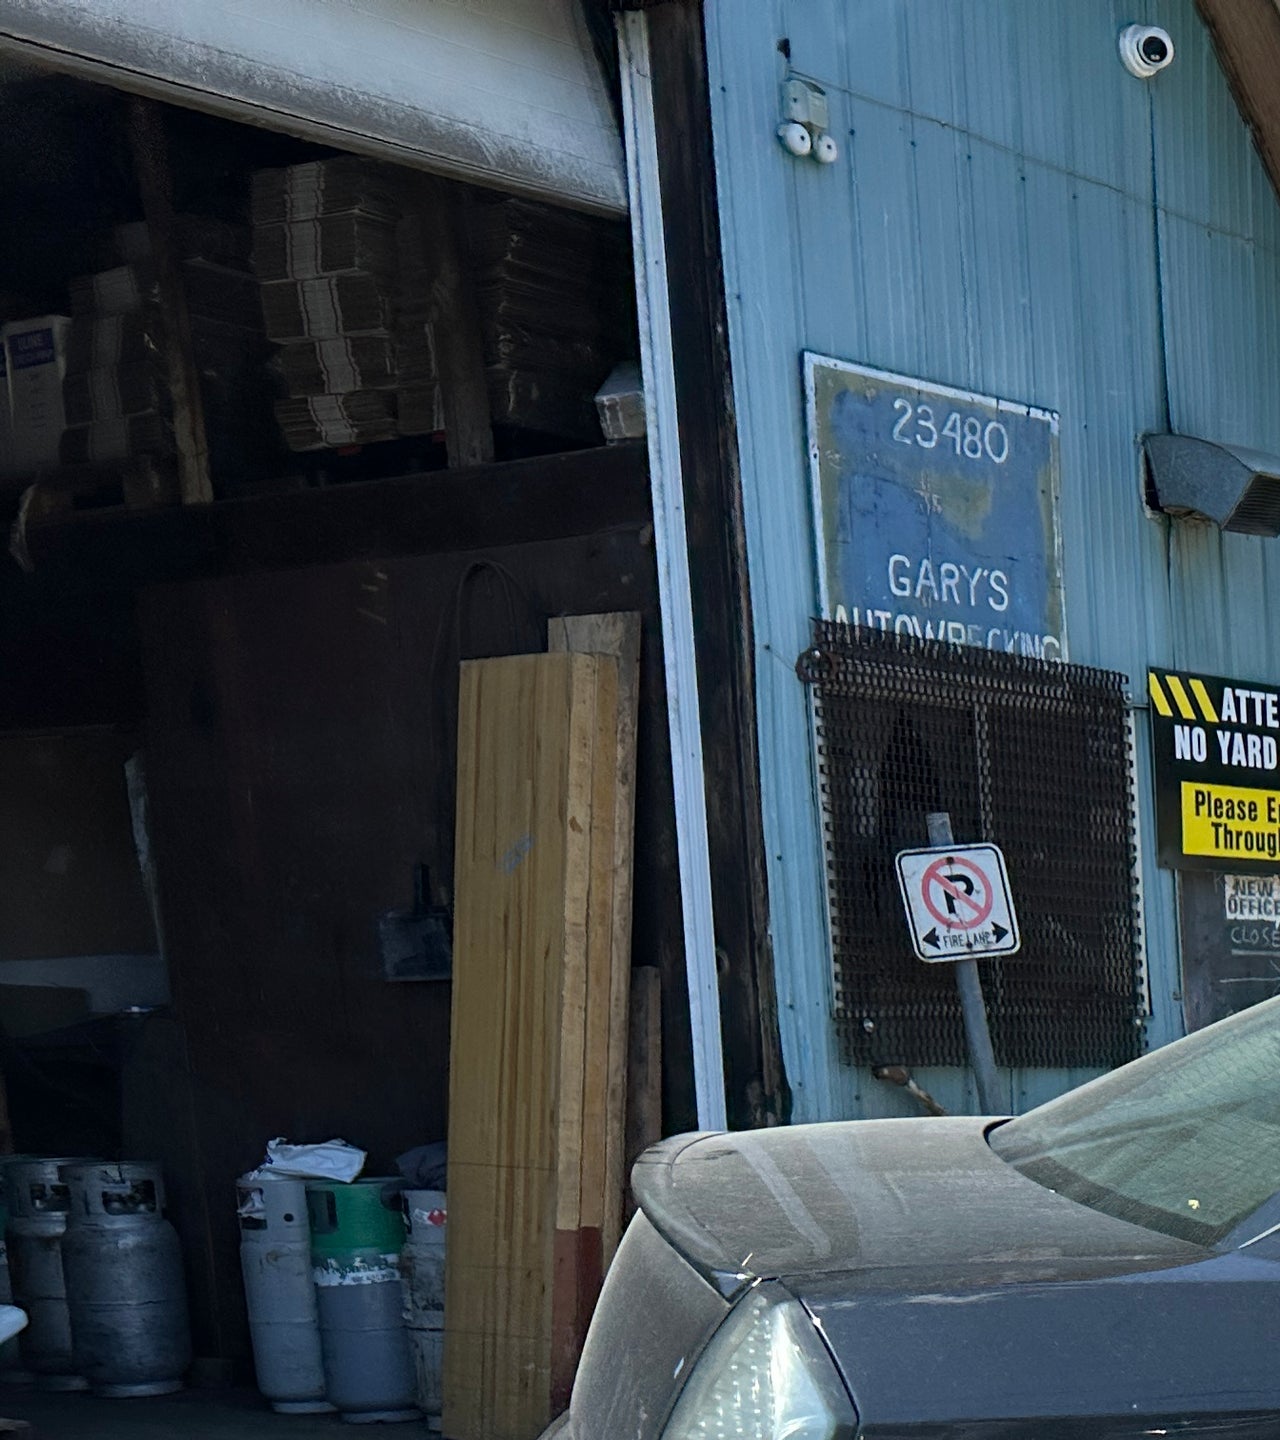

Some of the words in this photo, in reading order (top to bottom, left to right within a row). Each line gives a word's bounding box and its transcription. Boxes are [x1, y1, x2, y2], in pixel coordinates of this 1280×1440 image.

[892, 398, 1009, 464] 23480
[888, 554, 1009, 612] GARY'S
[1174, 724, 1207, 763] NO
[1216, 729, 1278, 770] YARD
[1193, 789, 1258, 822] Please
[1233, 877, 1274, 898] NEW
[943, 933, 964, 948] FIRE
